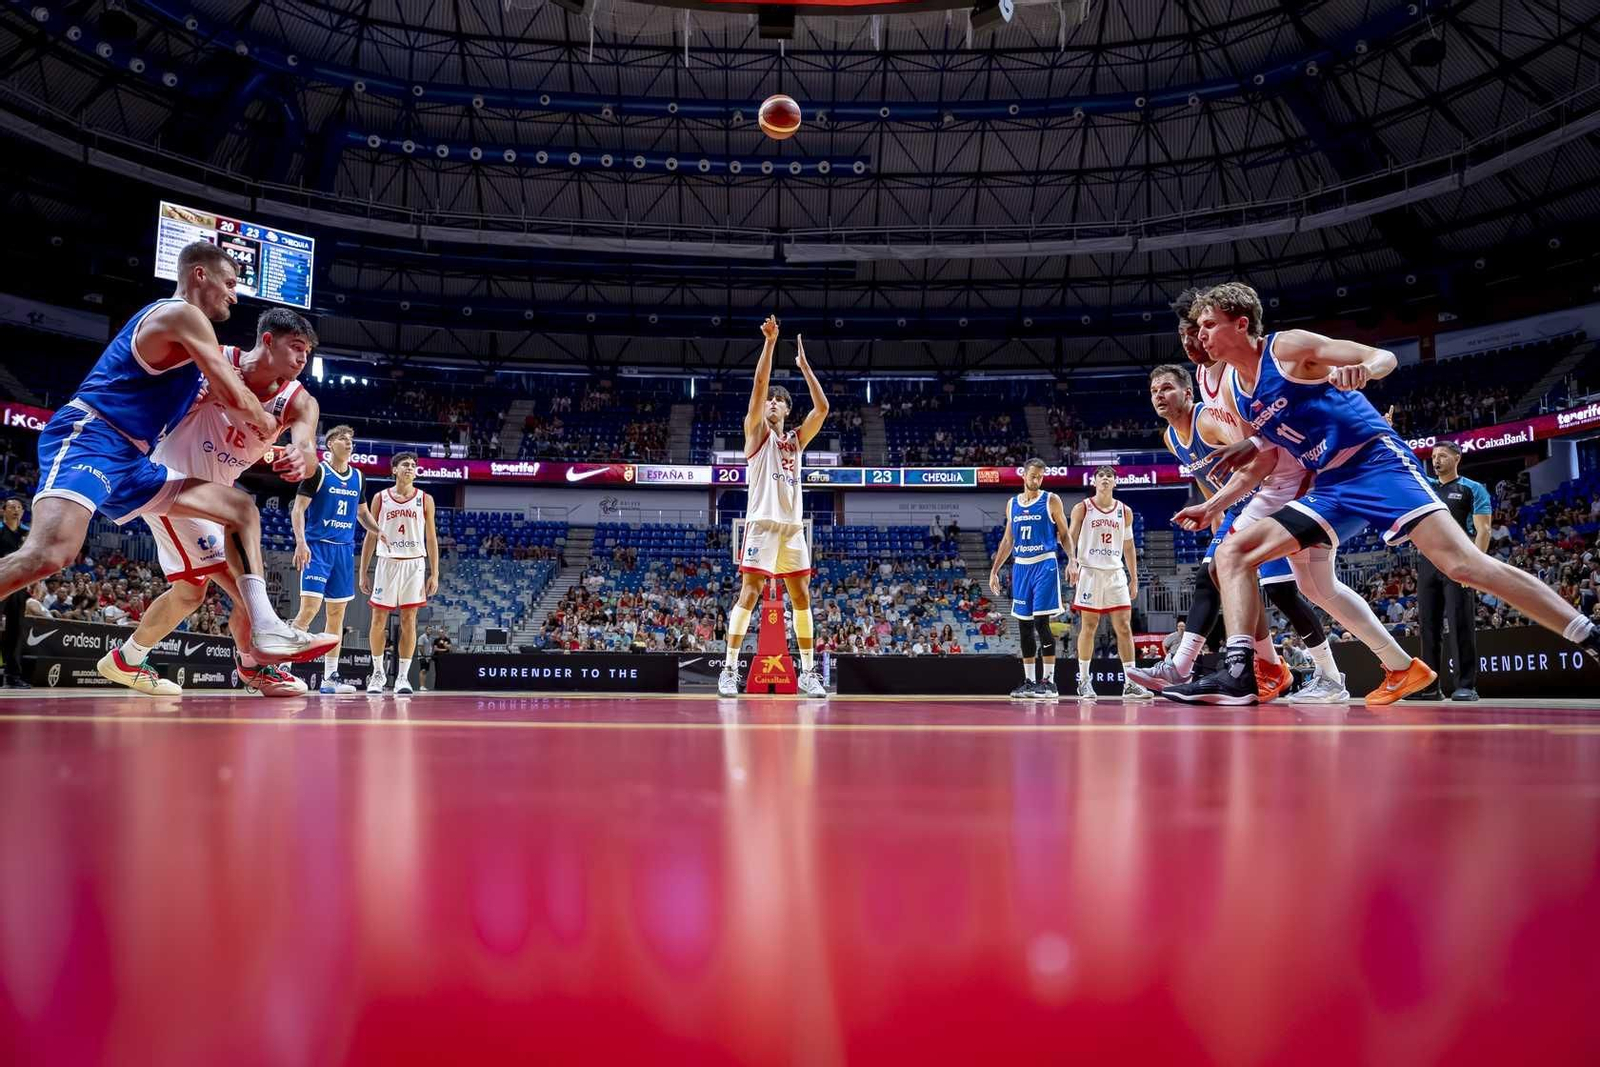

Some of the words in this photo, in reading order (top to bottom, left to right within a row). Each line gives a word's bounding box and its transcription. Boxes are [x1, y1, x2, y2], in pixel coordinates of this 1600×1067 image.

[220, 221, 234, 232] 20
[246, 227, 260, 239] 23
[1276, 423, 1306, 444] 11
[1476, 431, 1528, 450] CaixaBank
[415, 466, 462, 478] CaixaBank
[646, 468, 685, 480] ESPAÑA
[687, 470, 694, 480] B
[719, 469, 739, 481] 20
[872, 470, 893, 483] 23
[922, 472, 964, 482] CHEQUIA
[337, 500, 348, 516] 21
[398, 524, 405, 535] 4
[1020, 526, 1032, 539] 77
[1101, 533, 1112, 543] 12
[62, 632, 101, 649] endesa
[206, 644, 231, 657] endesa
[1559, 651, 1584, 669] TO
[478, 667, 572, 678] SURRENDER
[581, 668, 600, 678] TO
[609, 669, 638, 678] THE
[754, 675, 791, 684] CaixaBank
